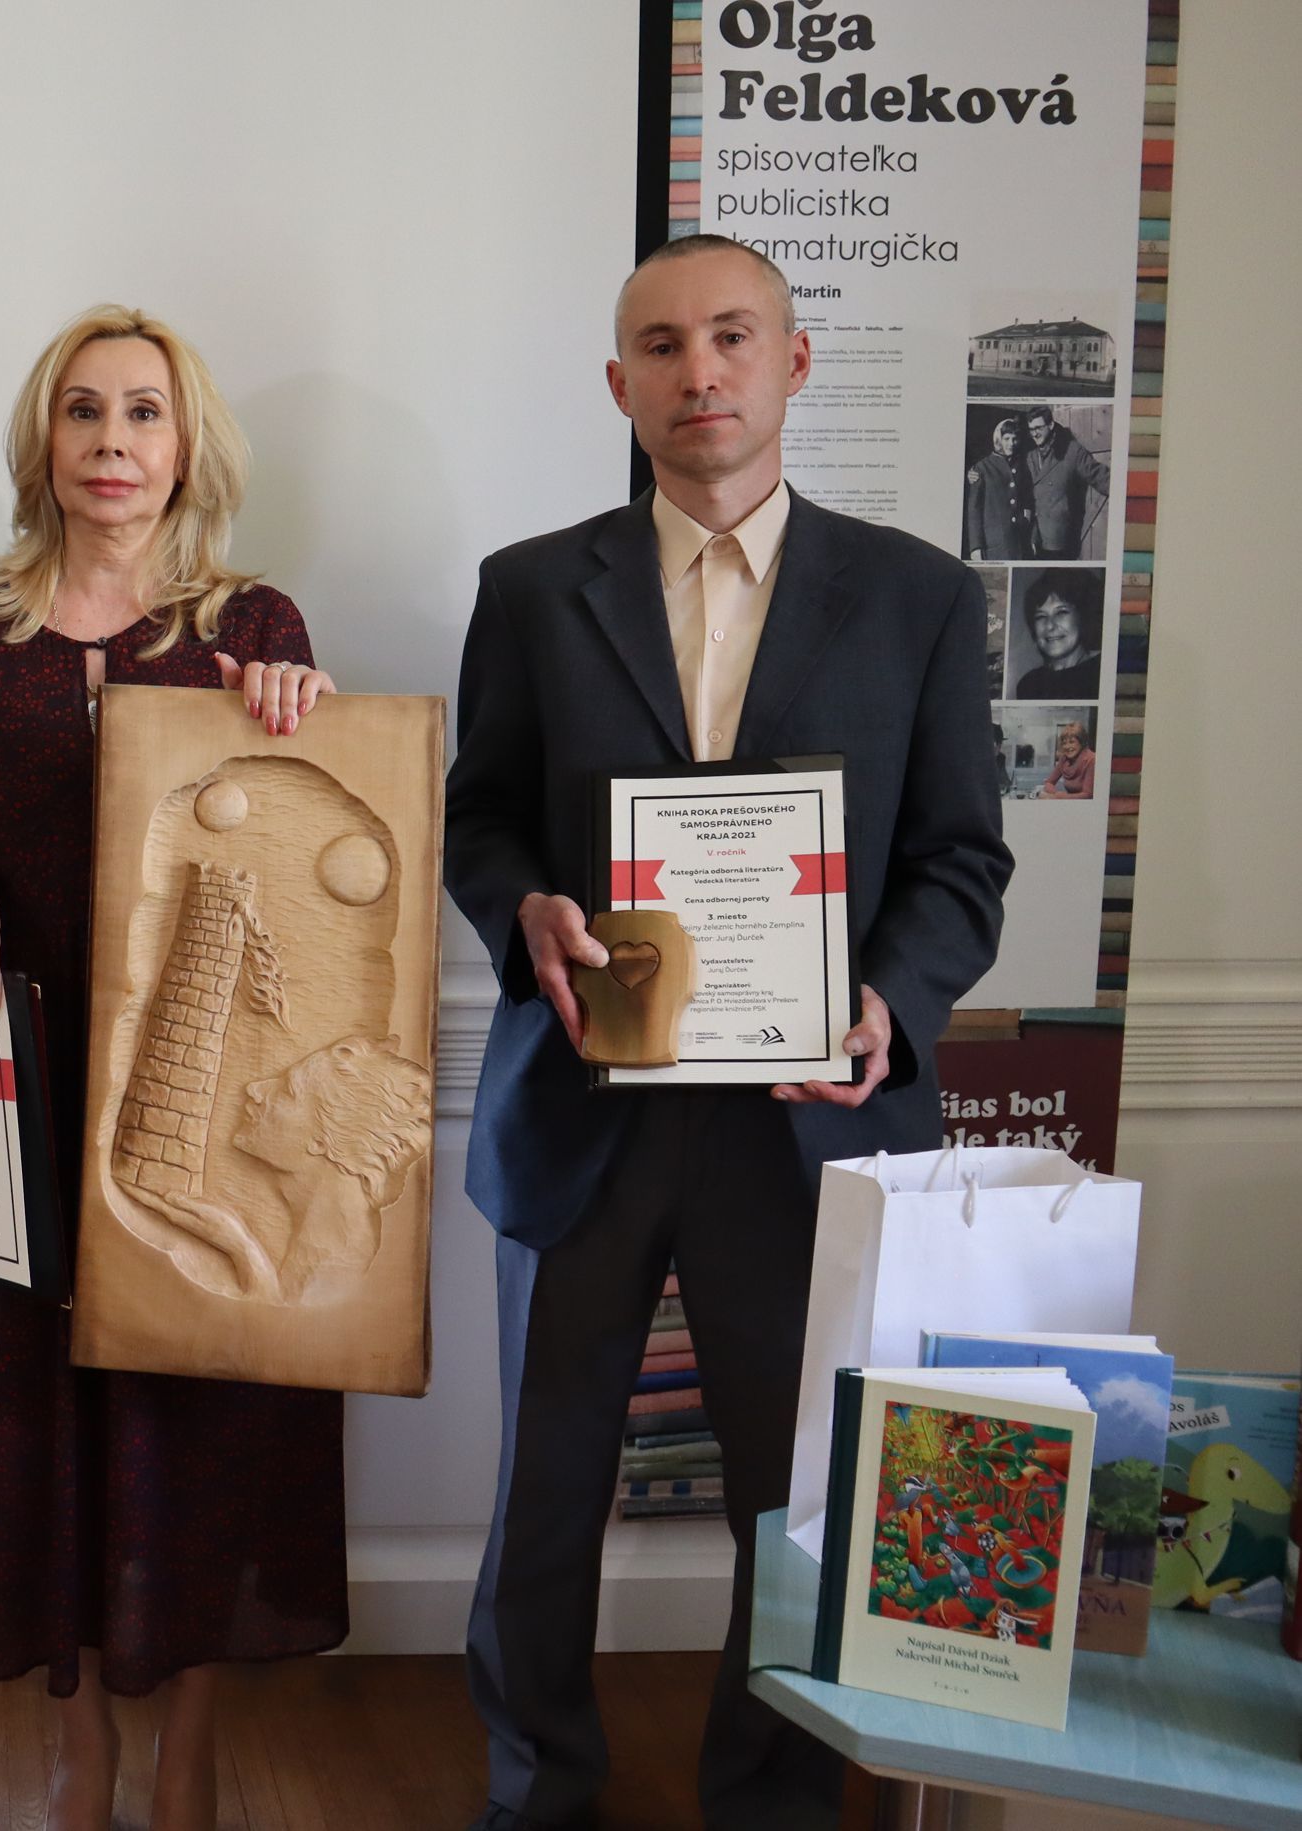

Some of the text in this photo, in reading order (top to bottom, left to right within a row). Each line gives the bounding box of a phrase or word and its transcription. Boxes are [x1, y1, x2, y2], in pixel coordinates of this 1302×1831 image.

[718, 70, 1077, 125] Feldeková
[717, 143, 917, 176] spisovateľka
[717, 188, 890, 221] publicistka
[790, 285, 841, 299] Martin
[657, 804, 796, 817] KNIHA ROKA PREŠOVSKÉHO
[680, 818, 773, 829] SAMOSPRÁVNEHO
[717, 848, 747, 856] ročník
[670, 868, 709, 876] Kategória
[710, 867, 744, 875] odborná
[706, 896, 741, 904] odbornej
[716, 935, 736, 943] Juraj
[737, 933, 764, 941] Ďurček
[1009, 1090, 1066, 1117] bol
[948, 1644, 978, 1660] Dávid
[896, 1648, 1020, 1682] Nakreslil Michal Souček
